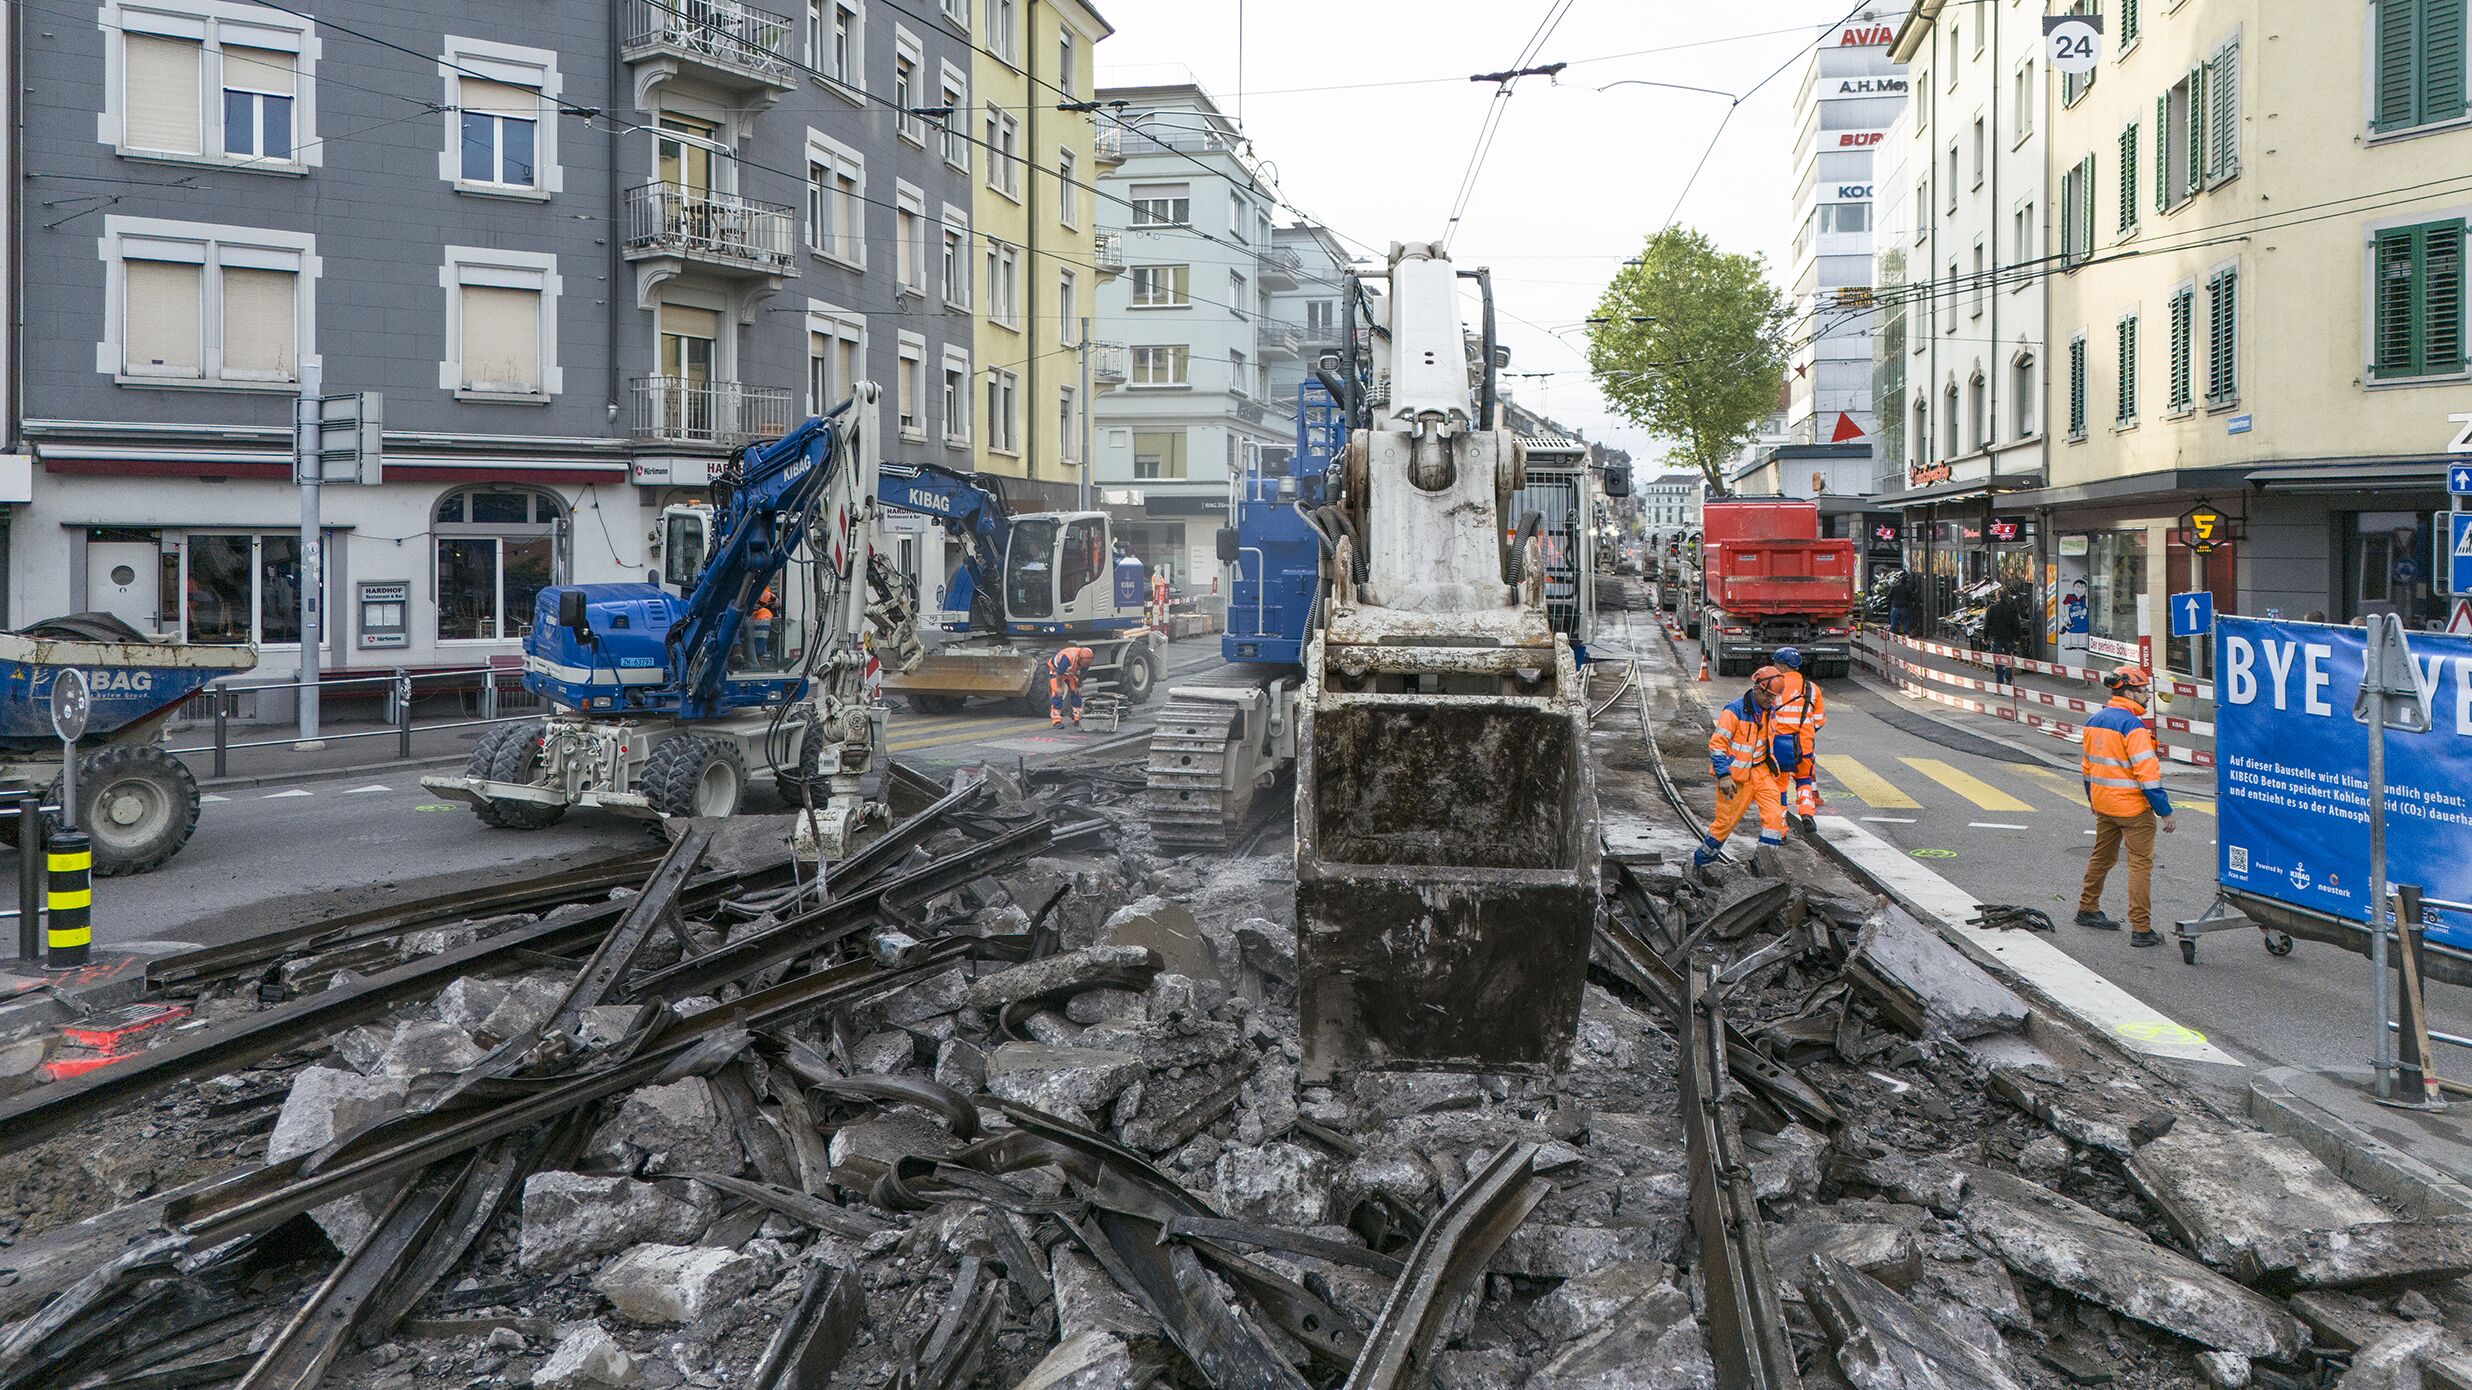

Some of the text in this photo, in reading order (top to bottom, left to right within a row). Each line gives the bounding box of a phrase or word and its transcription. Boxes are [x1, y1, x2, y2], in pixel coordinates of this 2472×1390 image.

[2056, 36, 2093, 58] 24
[783, 454, 812, 482] KIBAG
[909, 488, 949, 512] KIBAG
[2142, 646, 2150, 667] KIBAG
[58, 671, 152, 691] BAG
[2227, 636, 2472, 737] BYE YE
[2230, 755, 2244, 766] Auf
[2246, 758, 2272, 772] dieser
[2275, 763, 2316, 781] Baustelle
[2319, 772, 2339, 785] wird
[2424, 791, 2466, 808] gebaut:
[2230, 770, 2259, 785] KIBECO
[2261, 776, 2287, 790] Beton
[2289, 783, 2331, 800] speichert
[2230, 786, 2246, 797] und
[2248, 790, 2285, 805] entzieht
[2287, 798, 2297, 808] es
[2299, 800, 2309, 810] so
[2311, 801, 2327, 814] der
[2290, 870, 2310, 881] KIBAG
[2318, 884, 2351, 898] neustark
